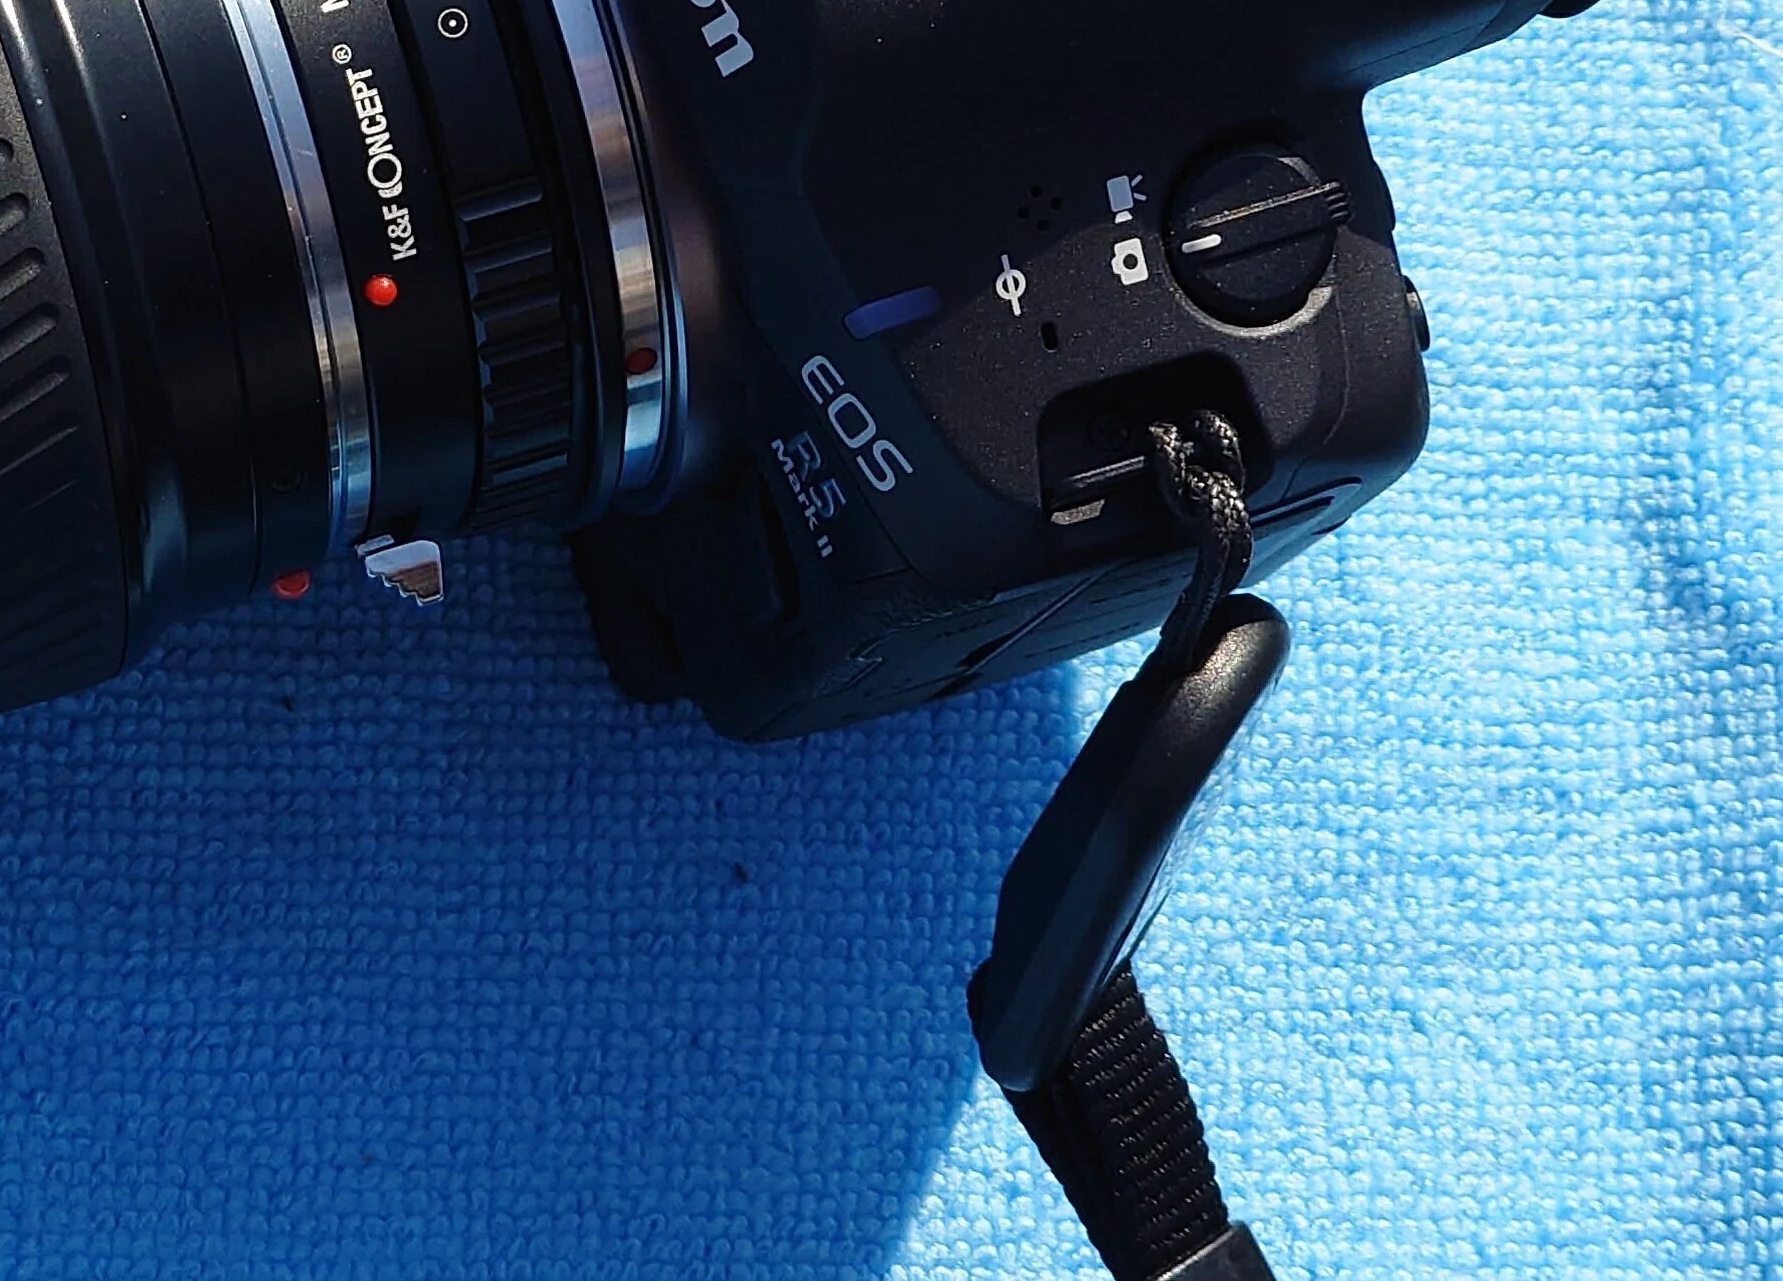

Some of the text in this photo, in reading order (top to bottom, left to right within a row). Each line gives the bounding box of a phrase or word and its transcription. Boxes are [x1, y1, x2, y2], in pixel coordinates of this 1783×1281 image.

[381, 203, 417, 261] K&F
[786, 430, 847, 517] R5
[801, 355, 914, 492] EOS
[771, 438, 833, 558] Mark II
